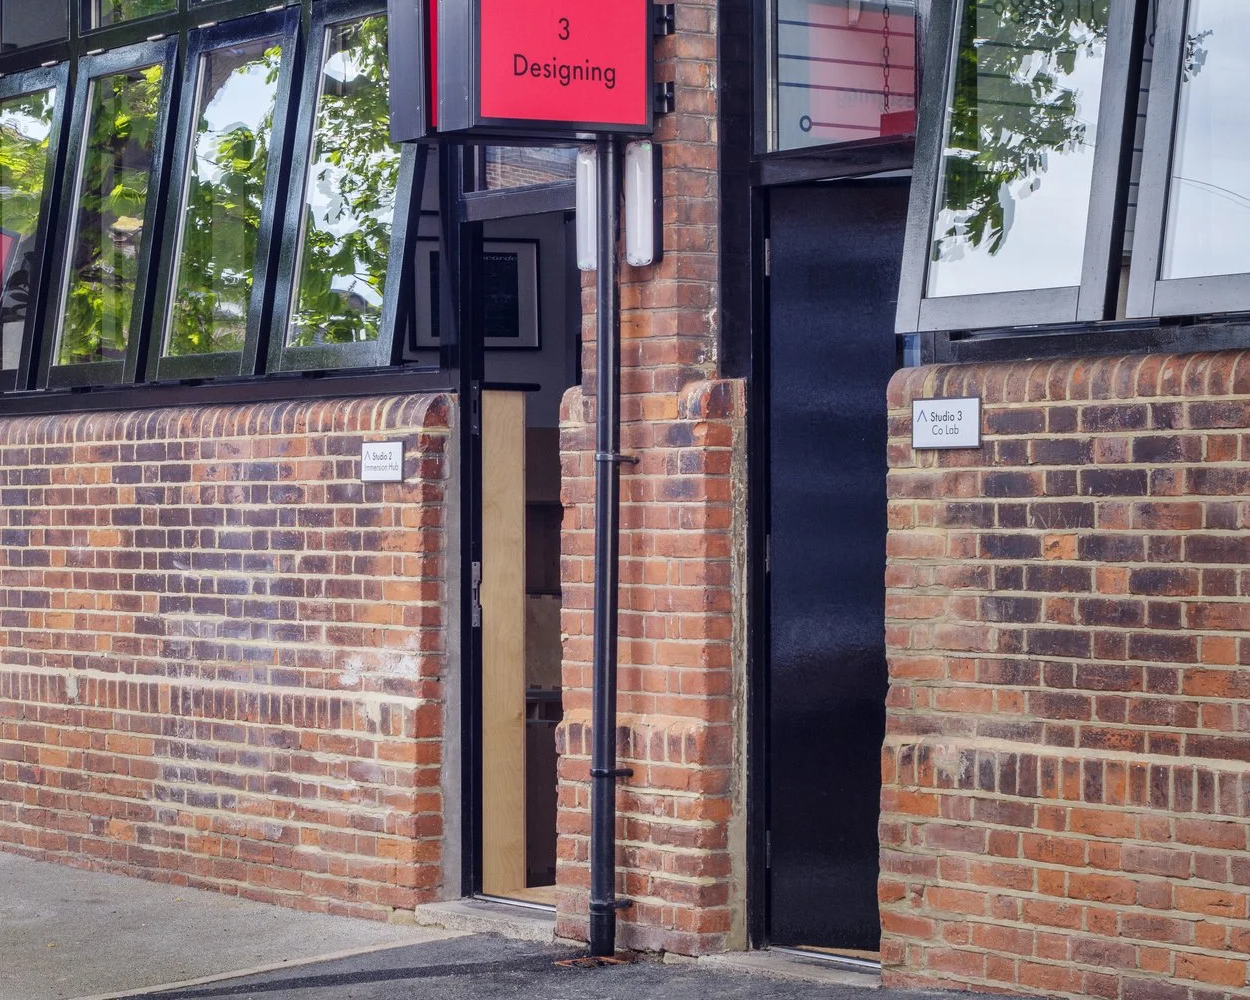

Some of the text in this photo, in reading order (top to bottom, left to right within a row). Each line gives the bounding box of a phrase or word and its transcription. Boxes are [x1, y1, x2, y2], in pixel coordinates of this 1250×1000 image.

[557, 17, 571, 41] 3
[513, 53, 617, 89] Designing
[930, 410, 963, 422] Studio 3
[931, 424, 959, 435] Co Lab
